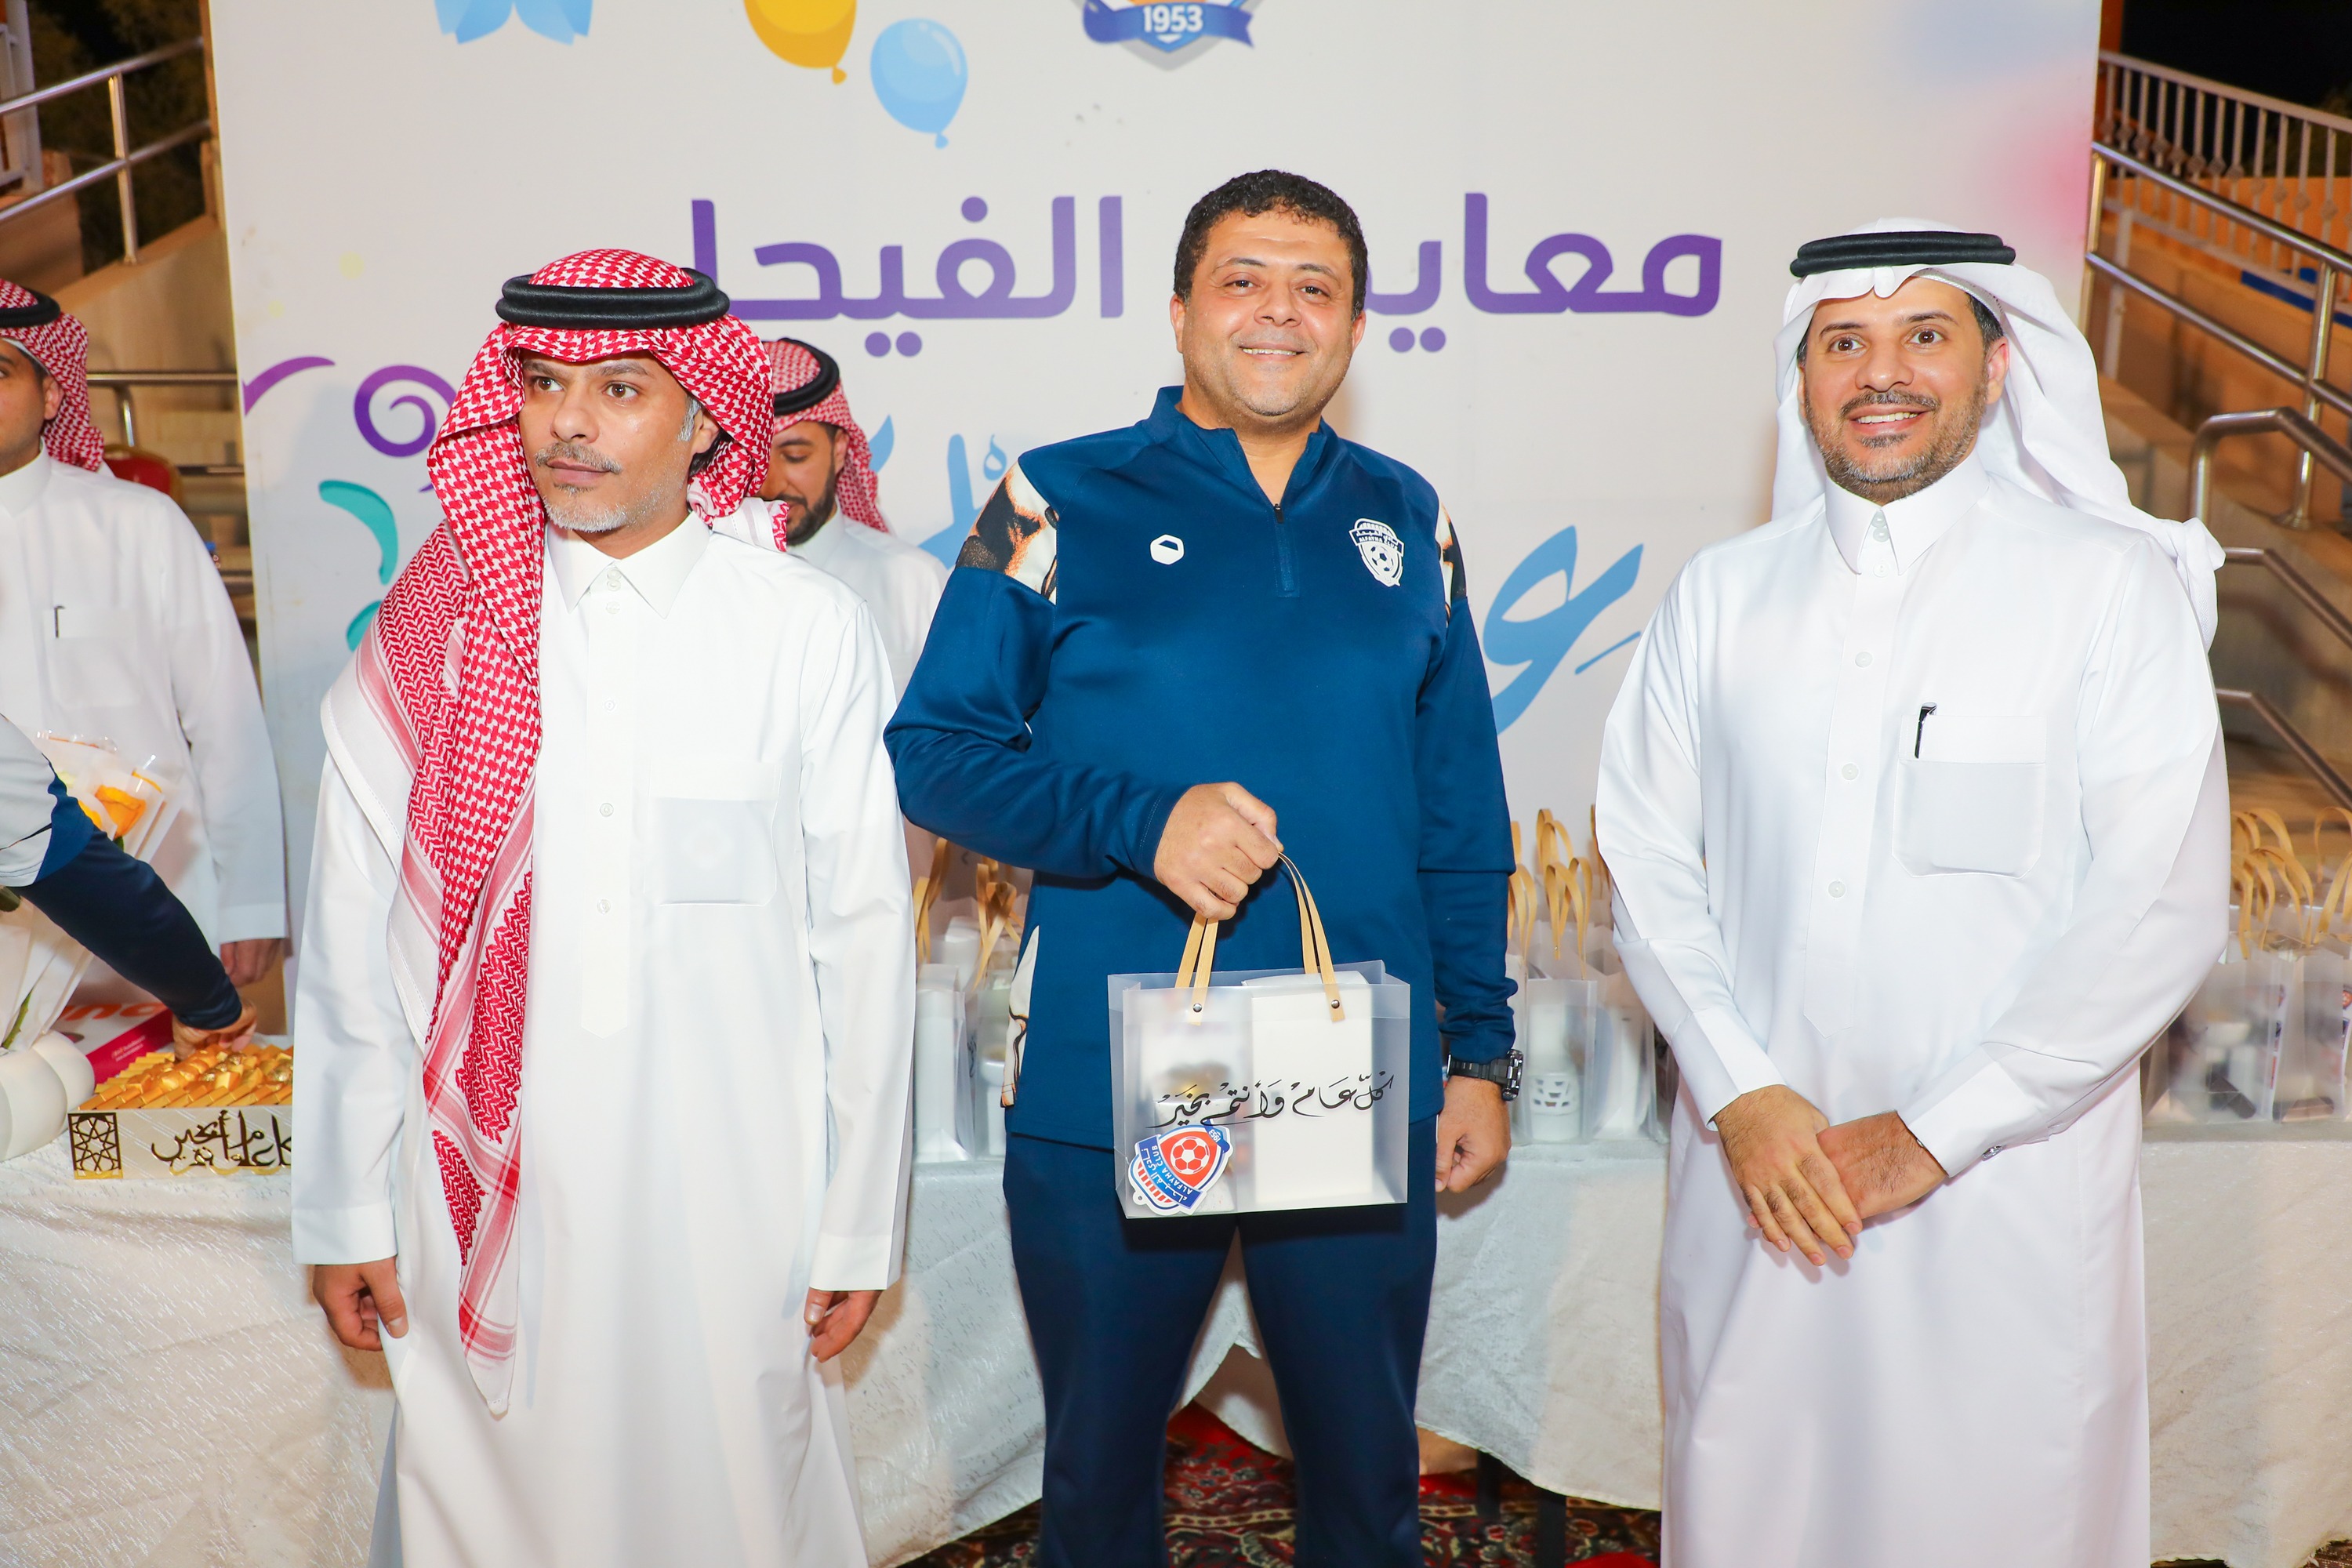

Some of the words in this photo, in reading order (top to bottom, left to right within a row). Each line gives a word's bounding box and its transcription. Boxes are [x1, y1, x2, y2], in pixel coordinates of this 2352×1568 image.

[1142, 4, 1204, 33] 1953
[691, 195, 1124, 358] الفيحا
[1367, 192, 1722, 354] معاي
[1208, 1129, 1221, 1143] 1953
[1151, 1145, 1164, 1167] CLUB
[1160, 1169, 1194, 1196] ALFAYHA
